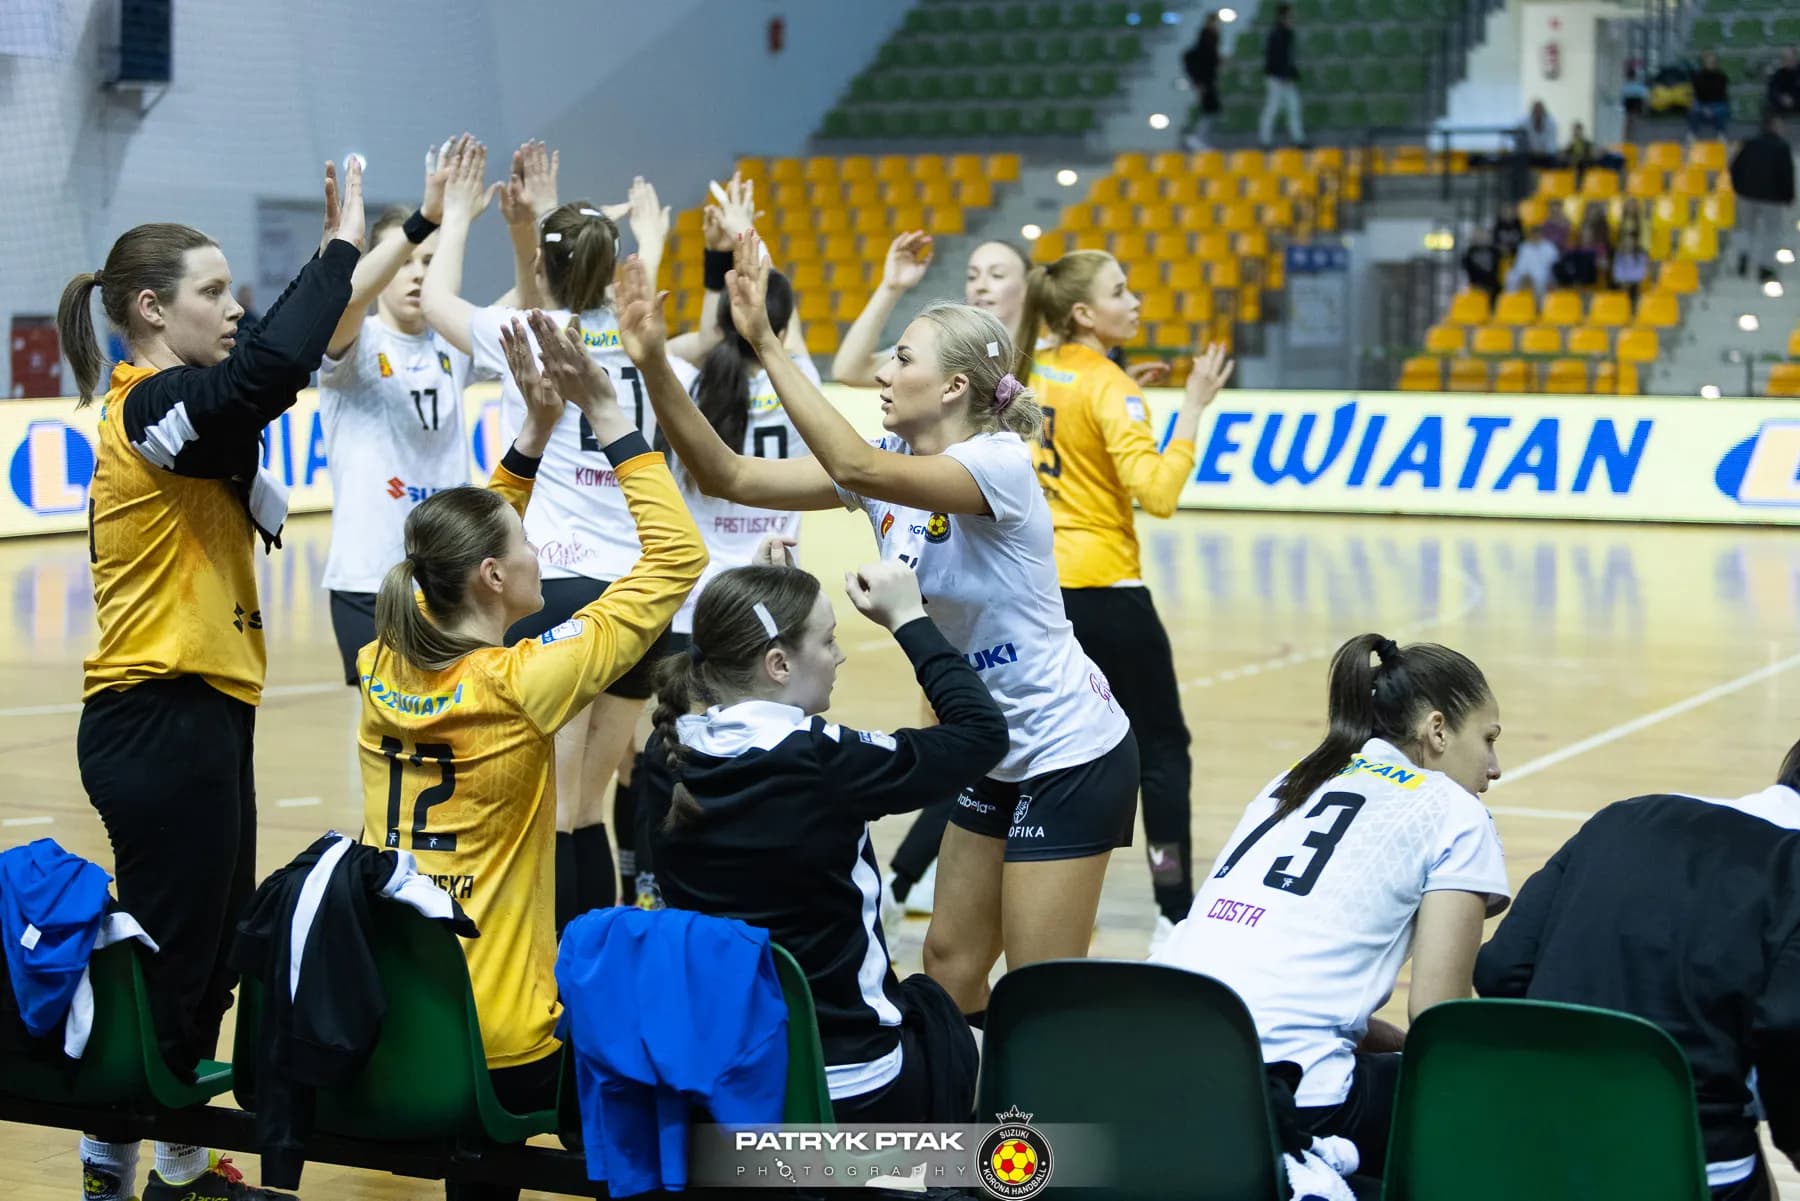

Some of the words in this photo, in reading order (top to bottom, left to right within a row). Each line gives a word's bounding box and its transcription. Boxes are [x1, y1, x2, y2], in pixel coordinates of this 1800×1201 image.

[410, 388, 439, 431] 17
[576, 467, 625, 487] KOWAL
[379, 735, 457, 851] 12
[1008, 825, 1046, 838] OFIKA
[1213, 790, 1367, 897] 73
[1207, 898, 1266, 928] COSTA
